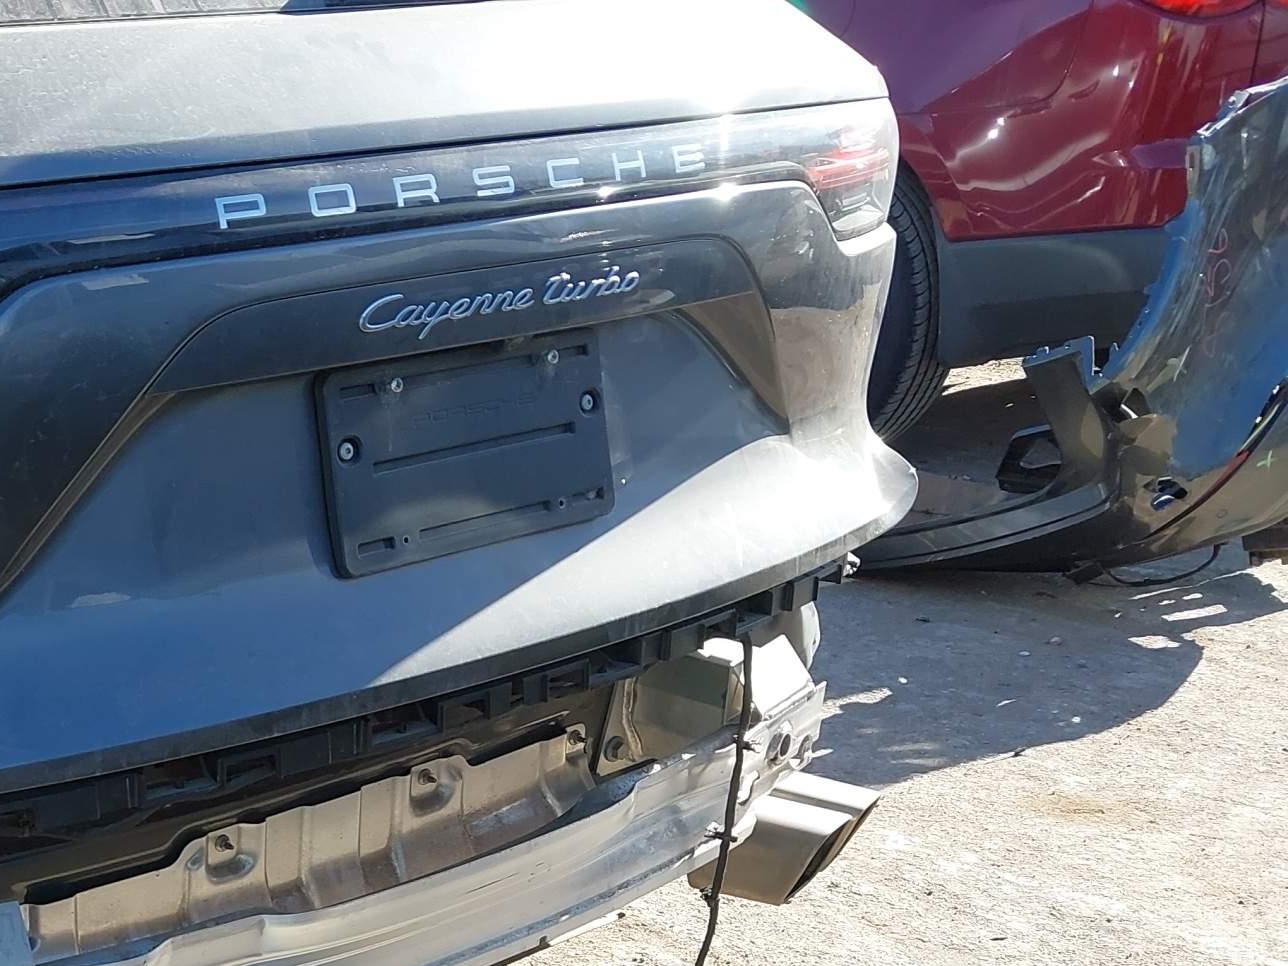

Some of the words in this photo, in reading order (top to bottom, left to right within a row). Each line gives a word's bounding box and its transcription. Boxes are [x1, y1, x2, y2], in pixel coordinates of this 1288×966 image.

[215, 143, 705, 229] PORSCHE
[358, 287, 535, 340] Cayenne
[542, 266, 641, 305] turbo
